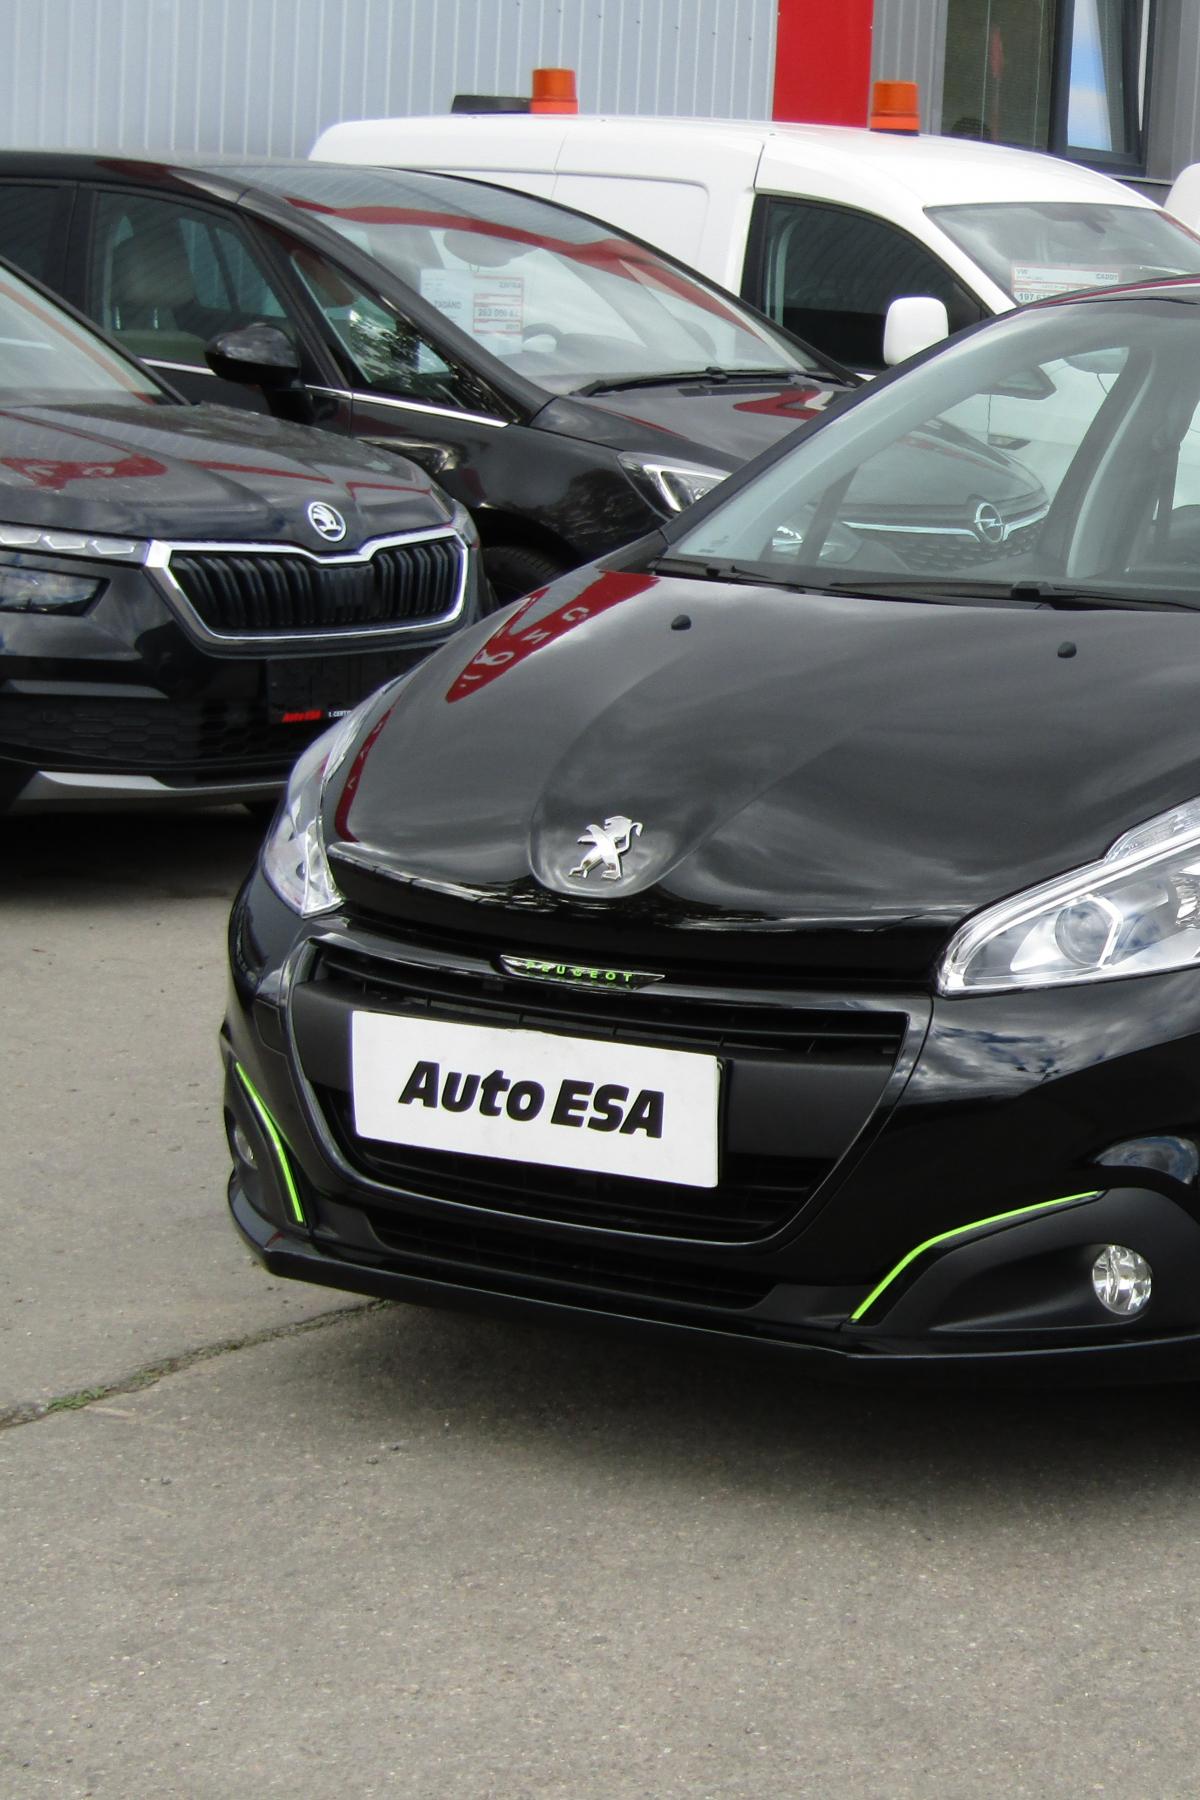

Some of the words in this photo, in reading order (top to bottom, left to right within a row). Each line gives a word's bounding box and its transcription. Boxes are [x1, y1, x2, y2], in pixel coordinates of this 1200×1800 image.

[525, 955, 633, 982] PEUGEOT
[398, 1060, 545, 1122] Auto
[552, 1079, 664, 1139] ESA
